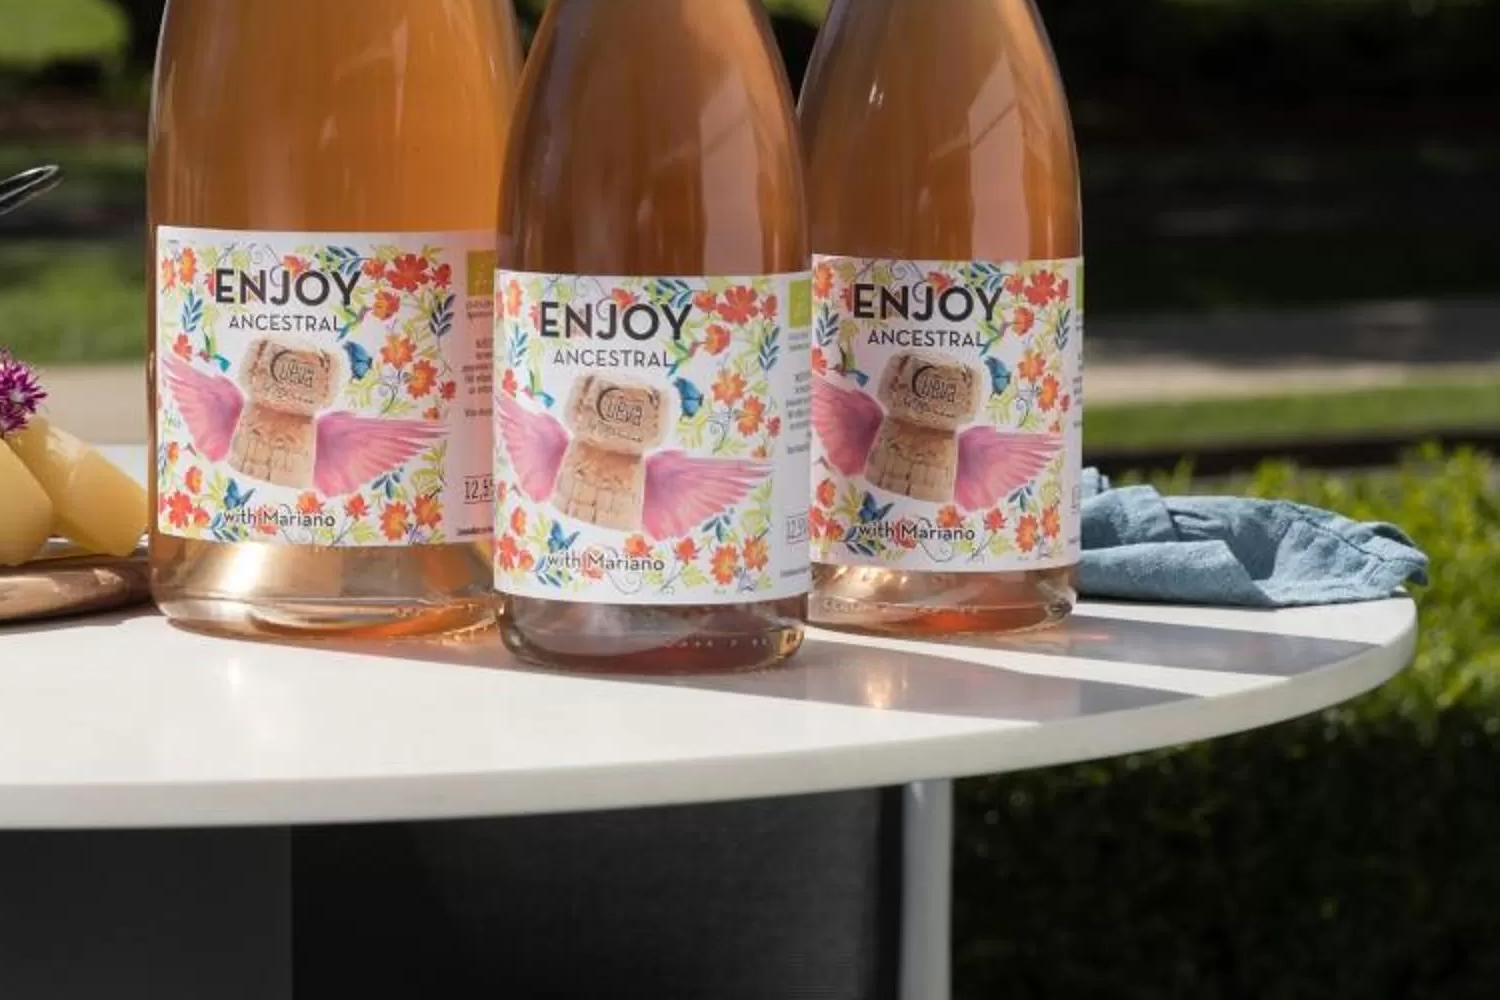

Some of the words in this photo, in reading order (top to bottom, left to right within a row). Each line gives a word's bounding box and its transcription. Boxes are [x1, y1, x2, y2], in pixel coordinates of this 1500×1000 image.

[215, 268, 361, 306] ENJOY
[852, 283, 1003, 322] ENJOY
[228, 314, 344, 332] ANCESTRAL
[540, 301, 693, 341] ENJOY
[867, 329, 987, 348] ANCESTRAL
[553, 349, 677, 368] ANCESTRAL
[223, 506, 258, 528] with
[263, 509, 336, 528] Mariano
[859, 520, 895, 541] with
[901, 523, 976, 541] Mariano
[547, 550, 582, 571] with
[587, 552, 666, 572] Mariano
